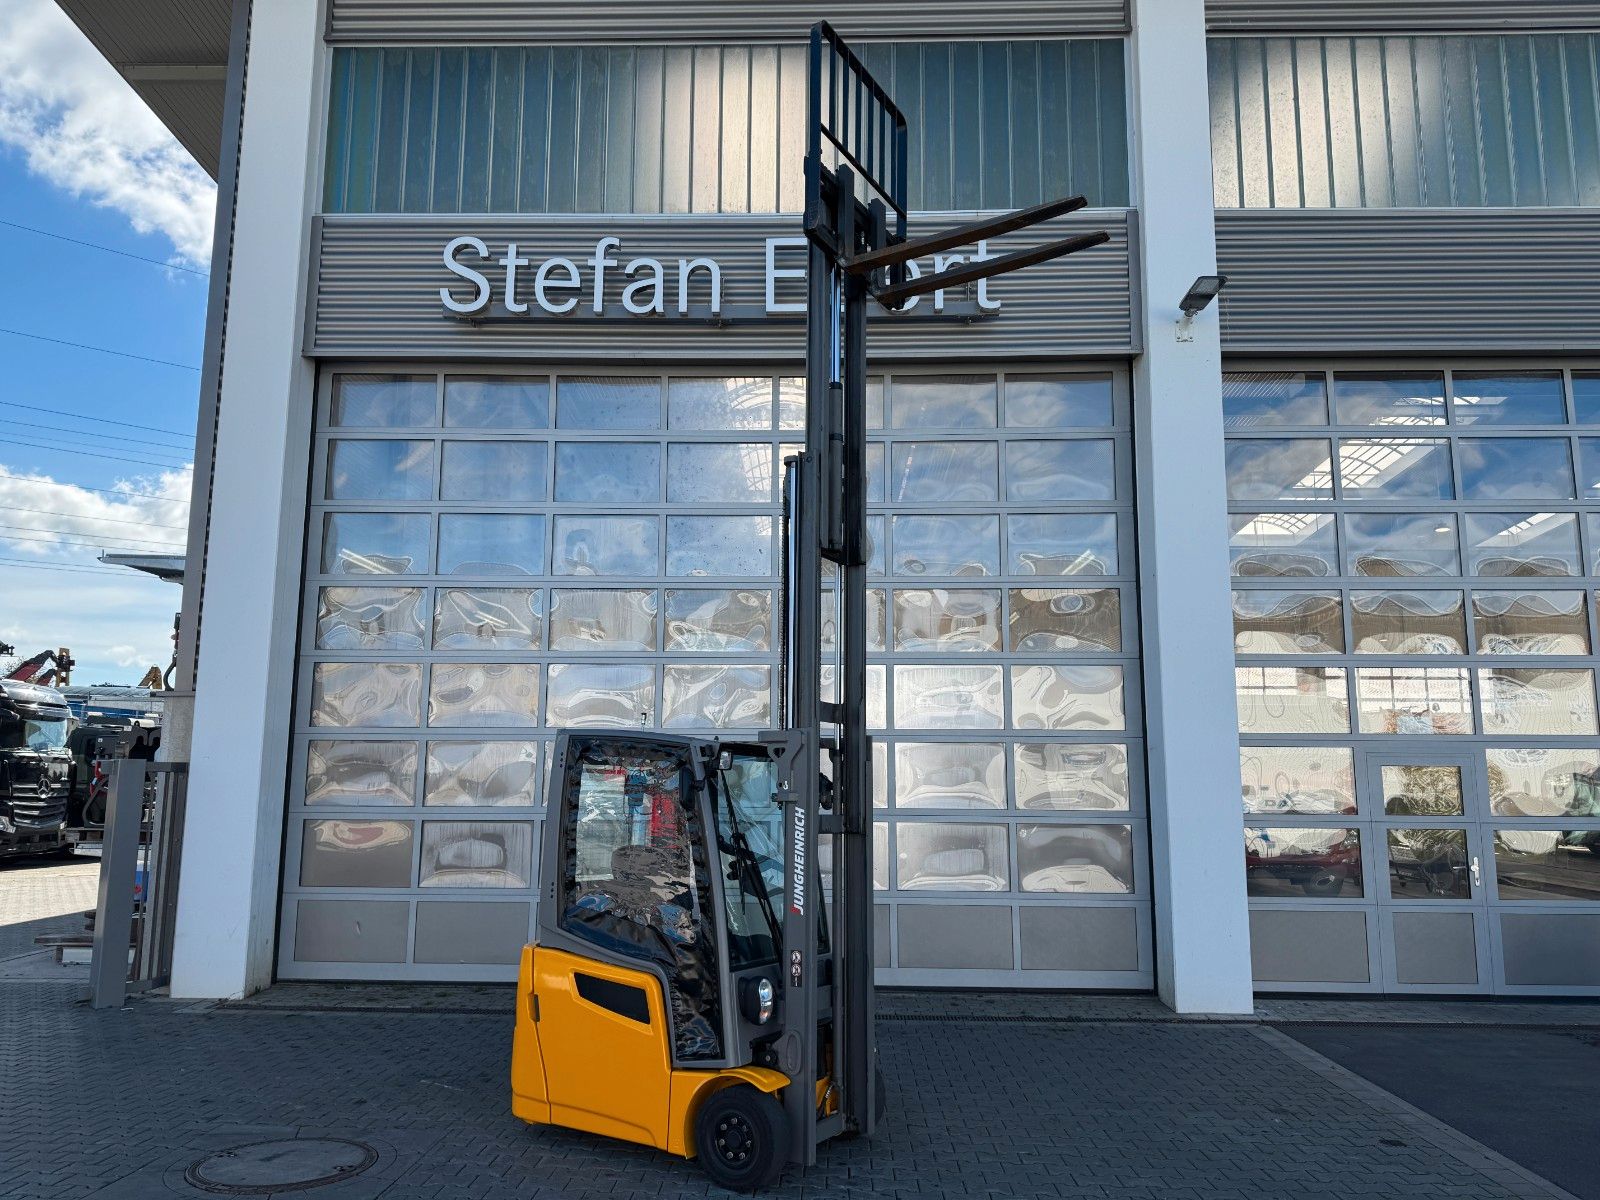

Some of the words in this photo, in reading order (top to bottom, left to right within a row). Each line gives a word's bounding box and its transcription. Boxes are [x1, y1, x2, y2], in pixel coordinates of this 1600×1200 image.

[439, 236, 721, 313] Stefan
[766, 237, 1001, 312] Ert
[792, 806, 805, 915] JUNGHEINRICH
